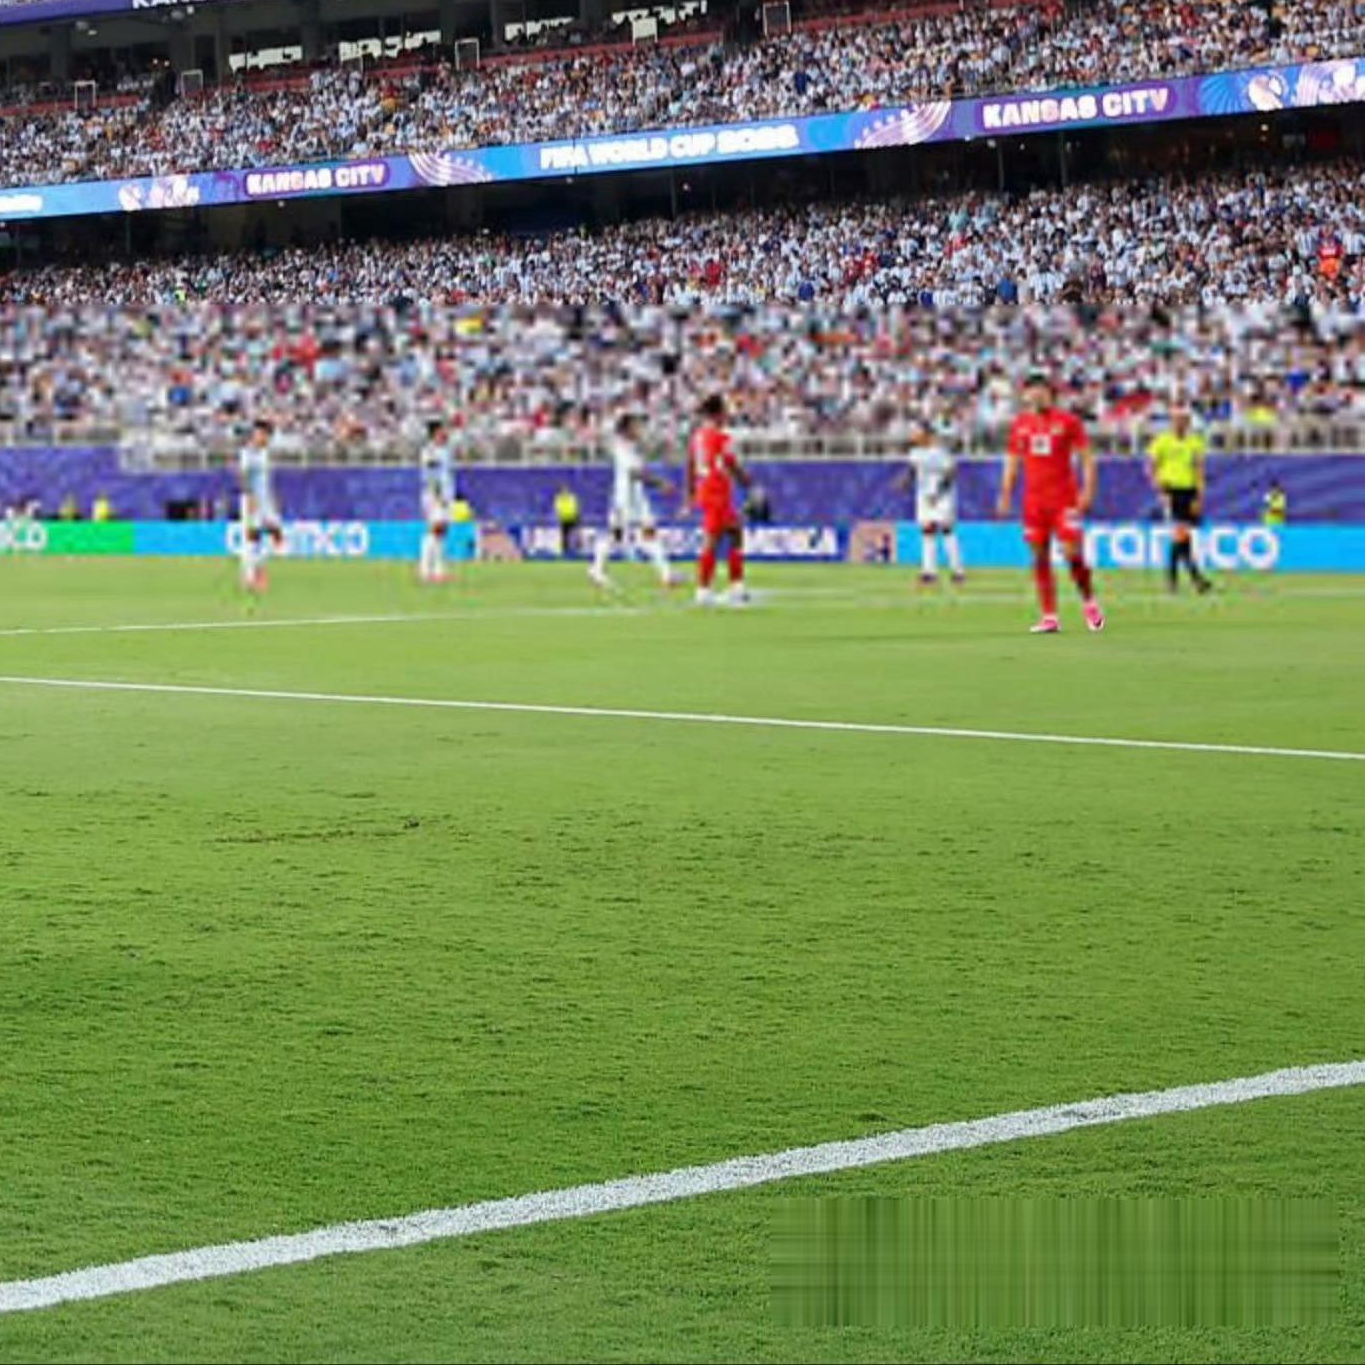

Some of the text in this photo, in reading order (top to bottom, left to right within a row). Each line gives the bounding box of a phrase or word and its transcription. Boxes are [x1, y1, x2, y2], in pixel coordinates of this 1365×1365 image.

[982, 88, 1168, 129] KANSAS CITY
[246, 164, 385, 195] KANSAS CITY
